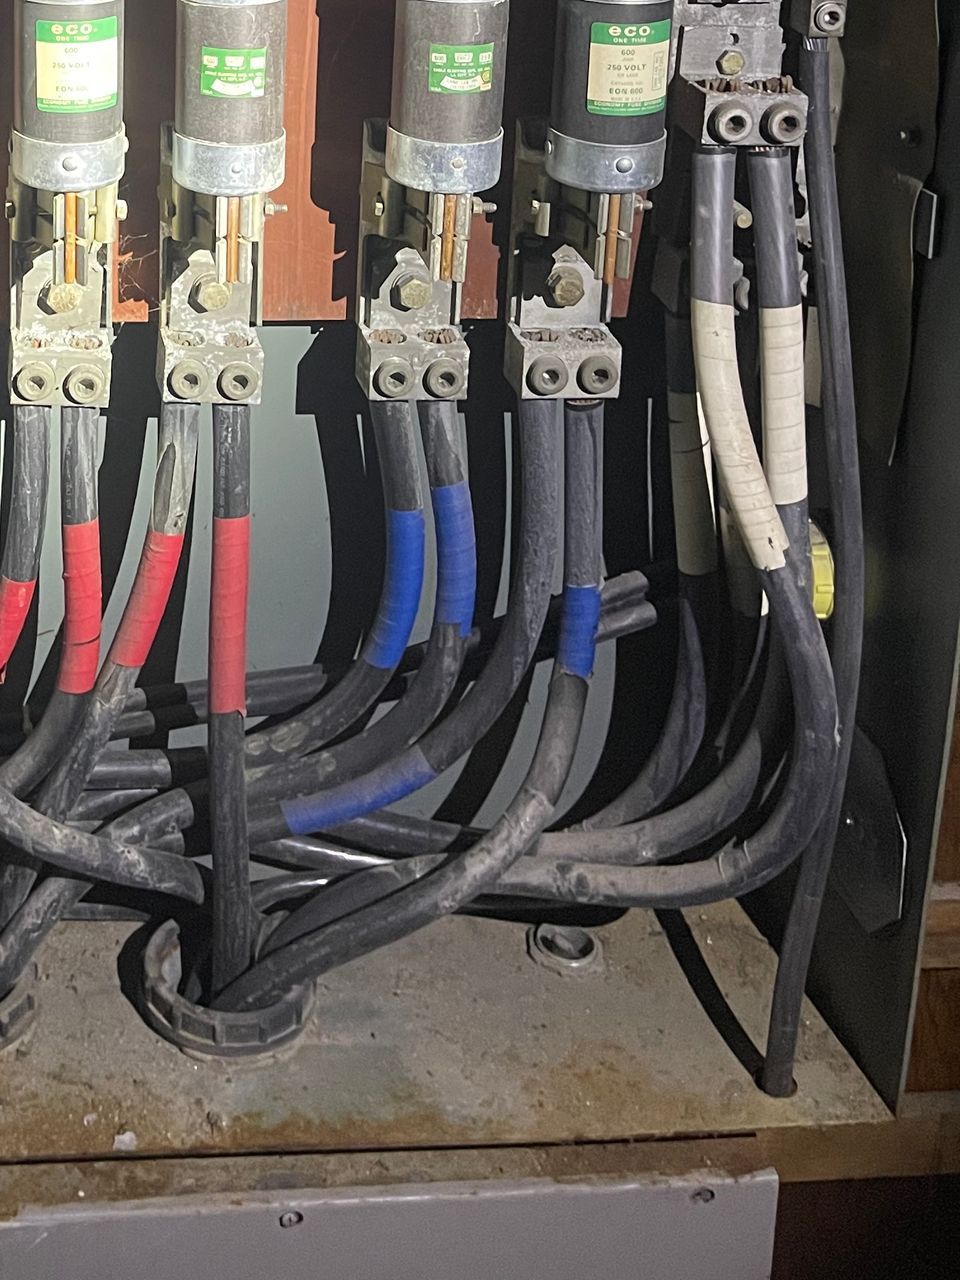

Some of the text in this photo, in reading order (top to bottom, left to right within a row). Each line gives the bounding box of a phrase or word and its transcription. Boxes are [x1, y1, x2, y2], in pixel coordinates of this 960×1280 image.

[50, 23, 93, 35] eco
[608, 25, 651, 37] eco
[621, 48, 636, 56] 600
[607, 63, 647, 71] 250 VOLT
[609, 87, 628, 95] EON
